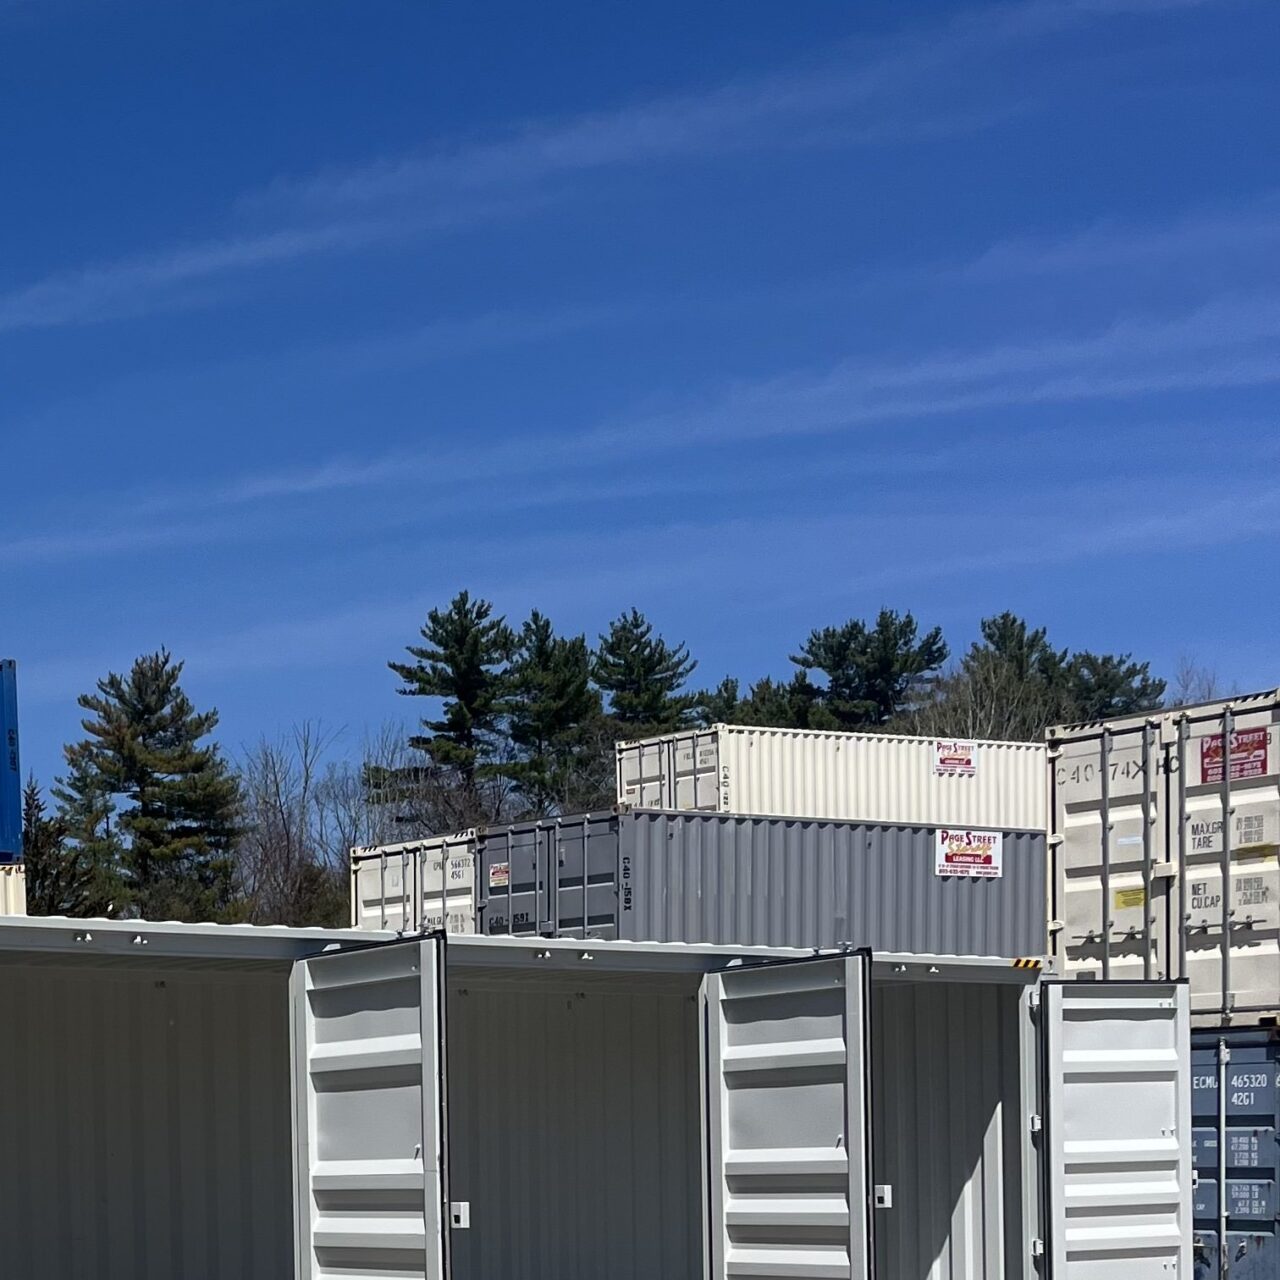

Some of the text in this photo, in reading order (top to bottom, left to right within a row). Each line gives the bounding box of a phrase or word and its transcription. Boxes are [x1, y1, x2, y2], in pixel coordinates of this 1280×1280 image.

[1230, 731, 1264, 748] STREET
[941, 830, 997, 846] PAGE STREET
[1192, 835, 1213, 850] TARE
[1192, 883, 1207, 895] NET
[1231, 1074, 1267, 1088] 465320
[1231, 1092, 1254, 1105] 42G1
